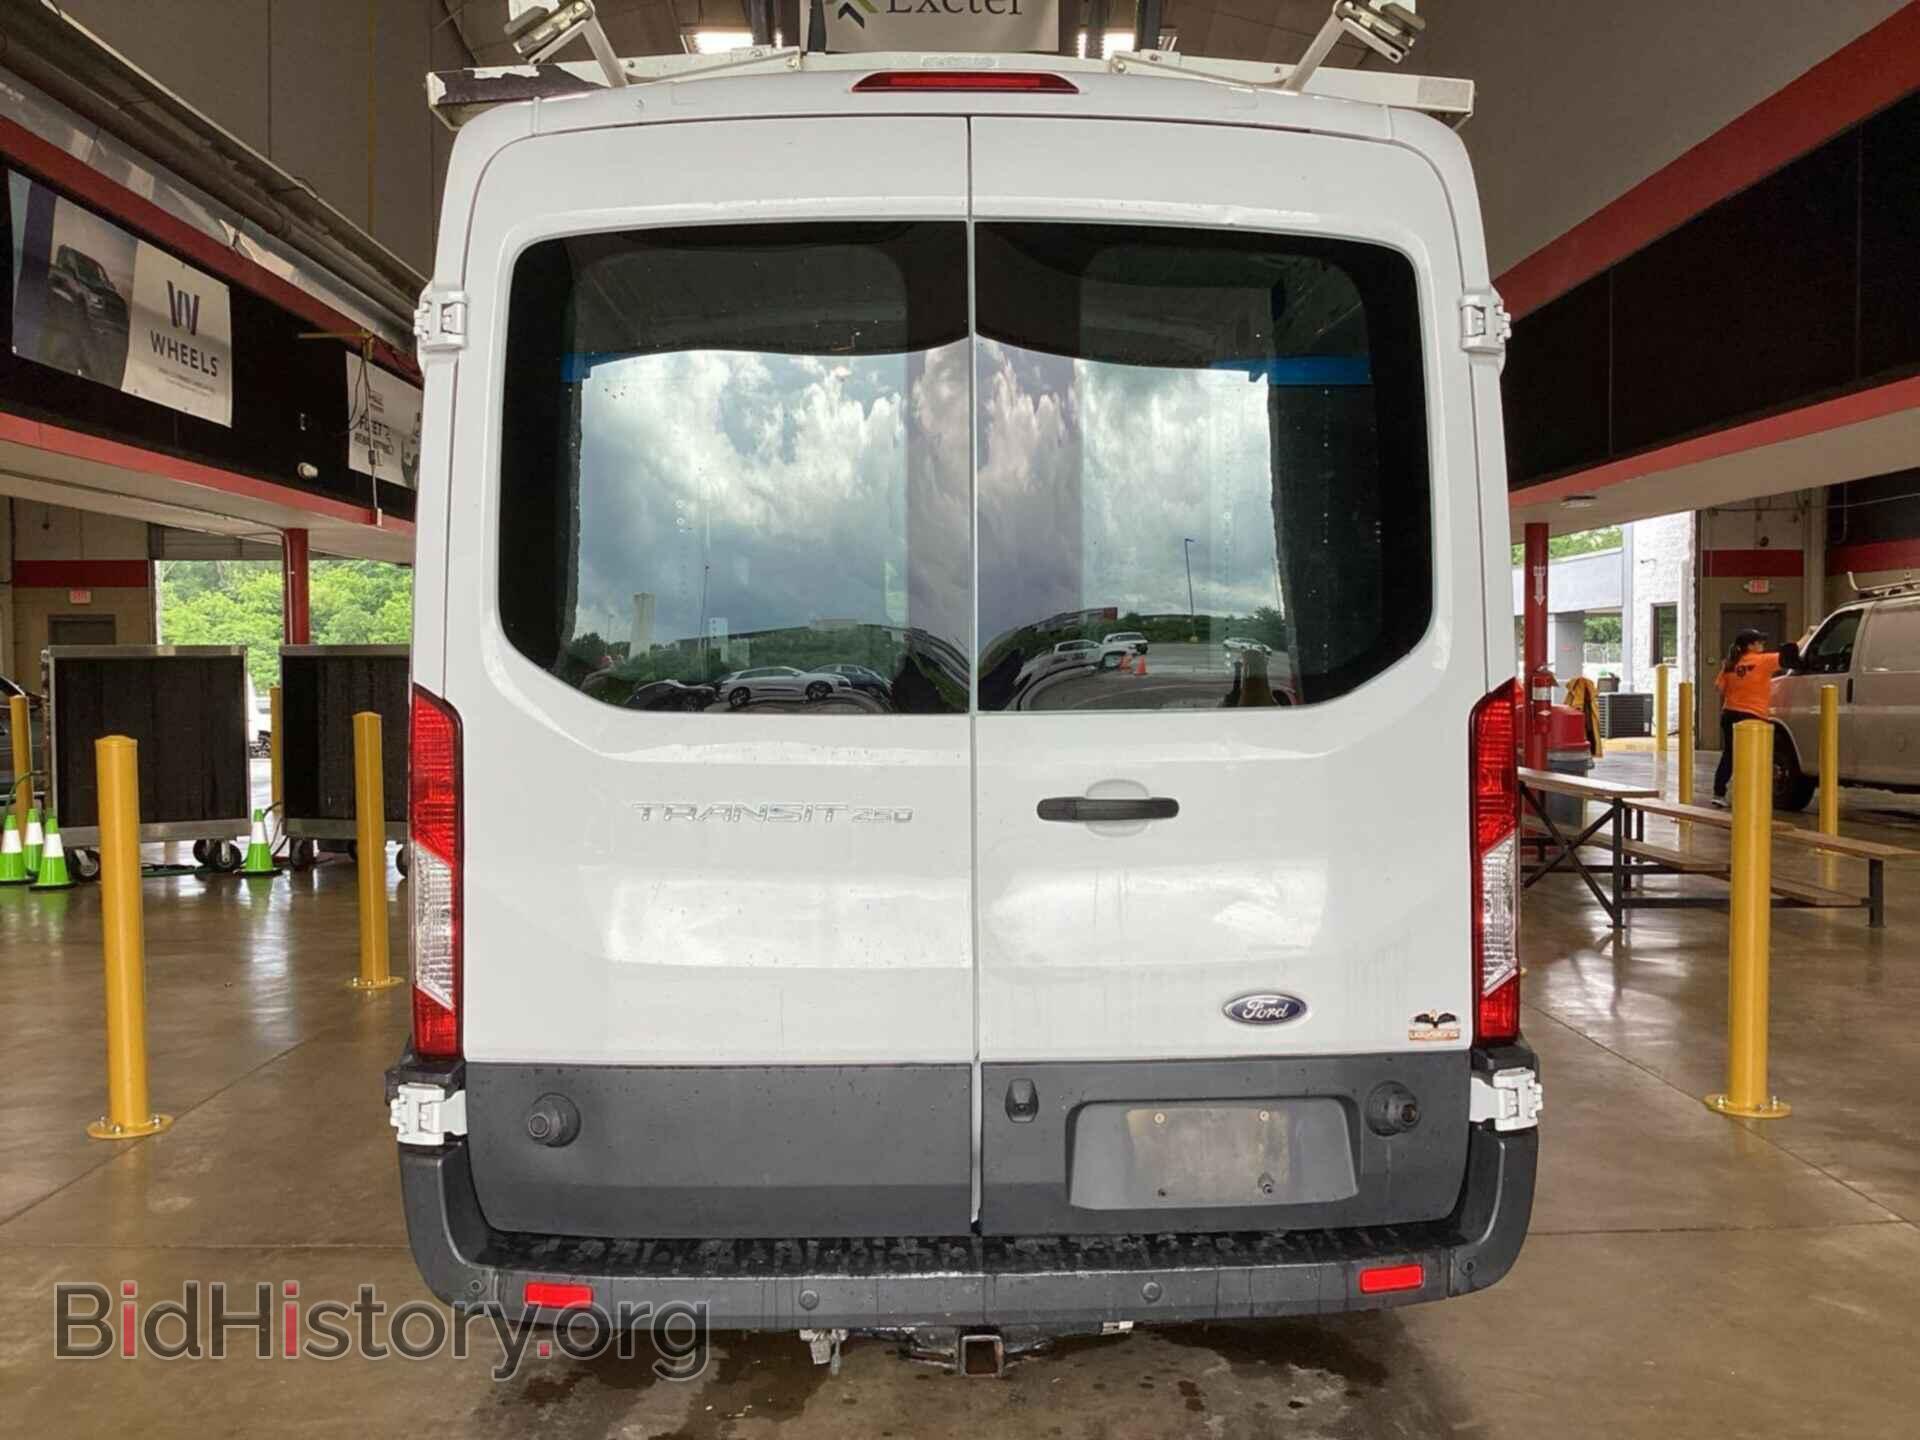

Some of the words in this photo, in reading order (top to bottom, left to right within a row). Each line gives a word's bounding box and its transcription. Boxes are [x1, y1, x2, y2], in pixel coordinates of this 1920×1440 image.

[150, 329, 219, 378] WHEELS
[632, 802, 849, 823] TRANSIT
[852, 806, 914, 824] 250
[1242, 999, 1289, 1019] Ford
